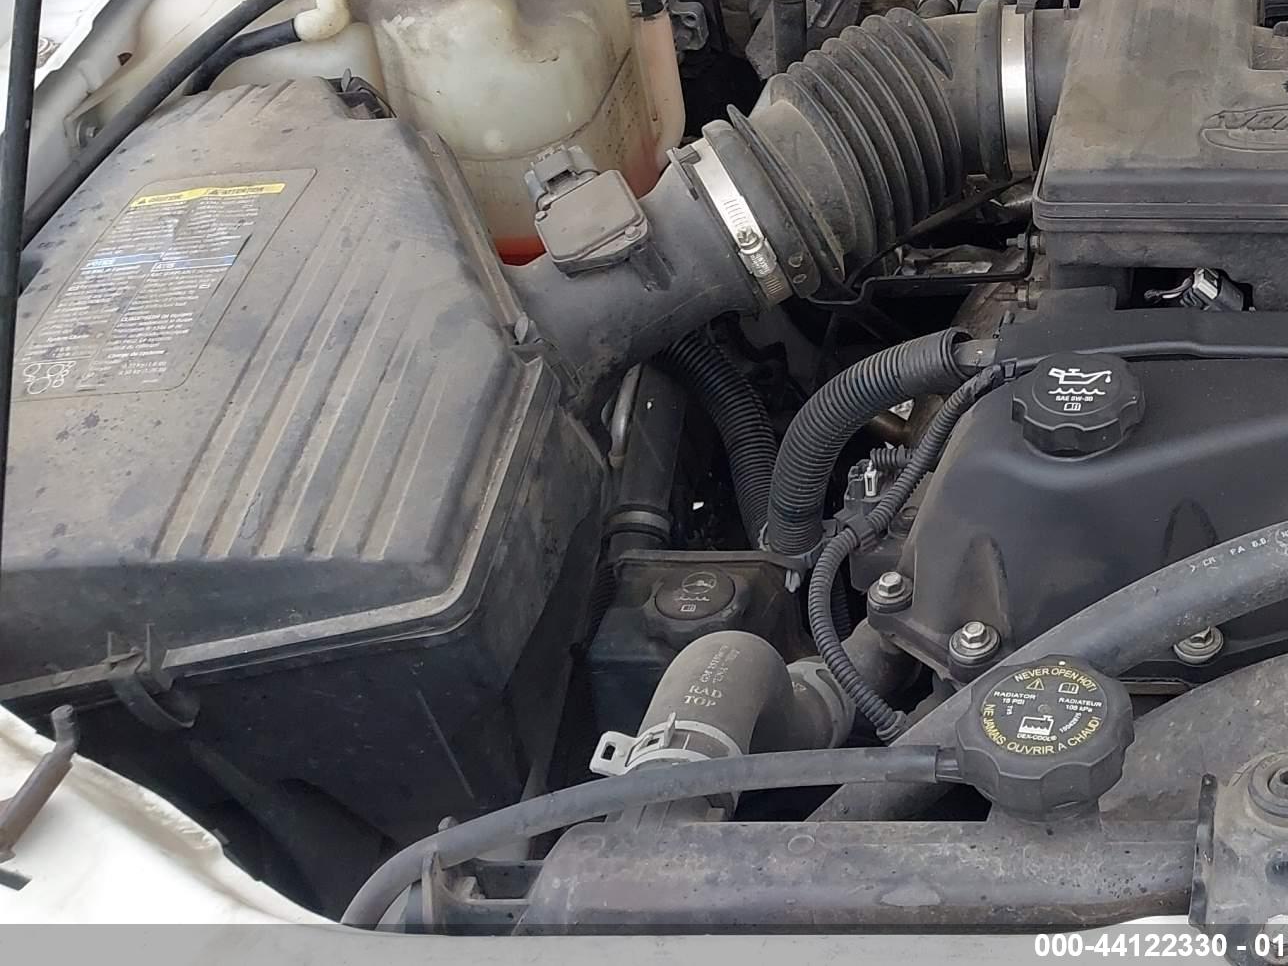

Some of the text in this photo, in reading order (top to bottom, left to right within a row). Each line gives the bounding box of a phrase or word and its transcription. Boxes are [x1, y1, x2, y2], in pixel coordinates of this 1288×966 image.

[1014, 667, 1098, 692] NEVER OPEN HOT!
[688, 684, 722, 698] RAD
[994, 691, 1037, 700] RADIATOR
[683, 695, 716, 707] TOP
[1058, 697, 1102, 708] RADIATEUR
[983, 704, 996, 716] NE
[982, 716, 1007, 745] JAMAIS
[1067, 716, 1102, 747] CHAUD!
[1007, 742, 1055, 755] OUVRIR
